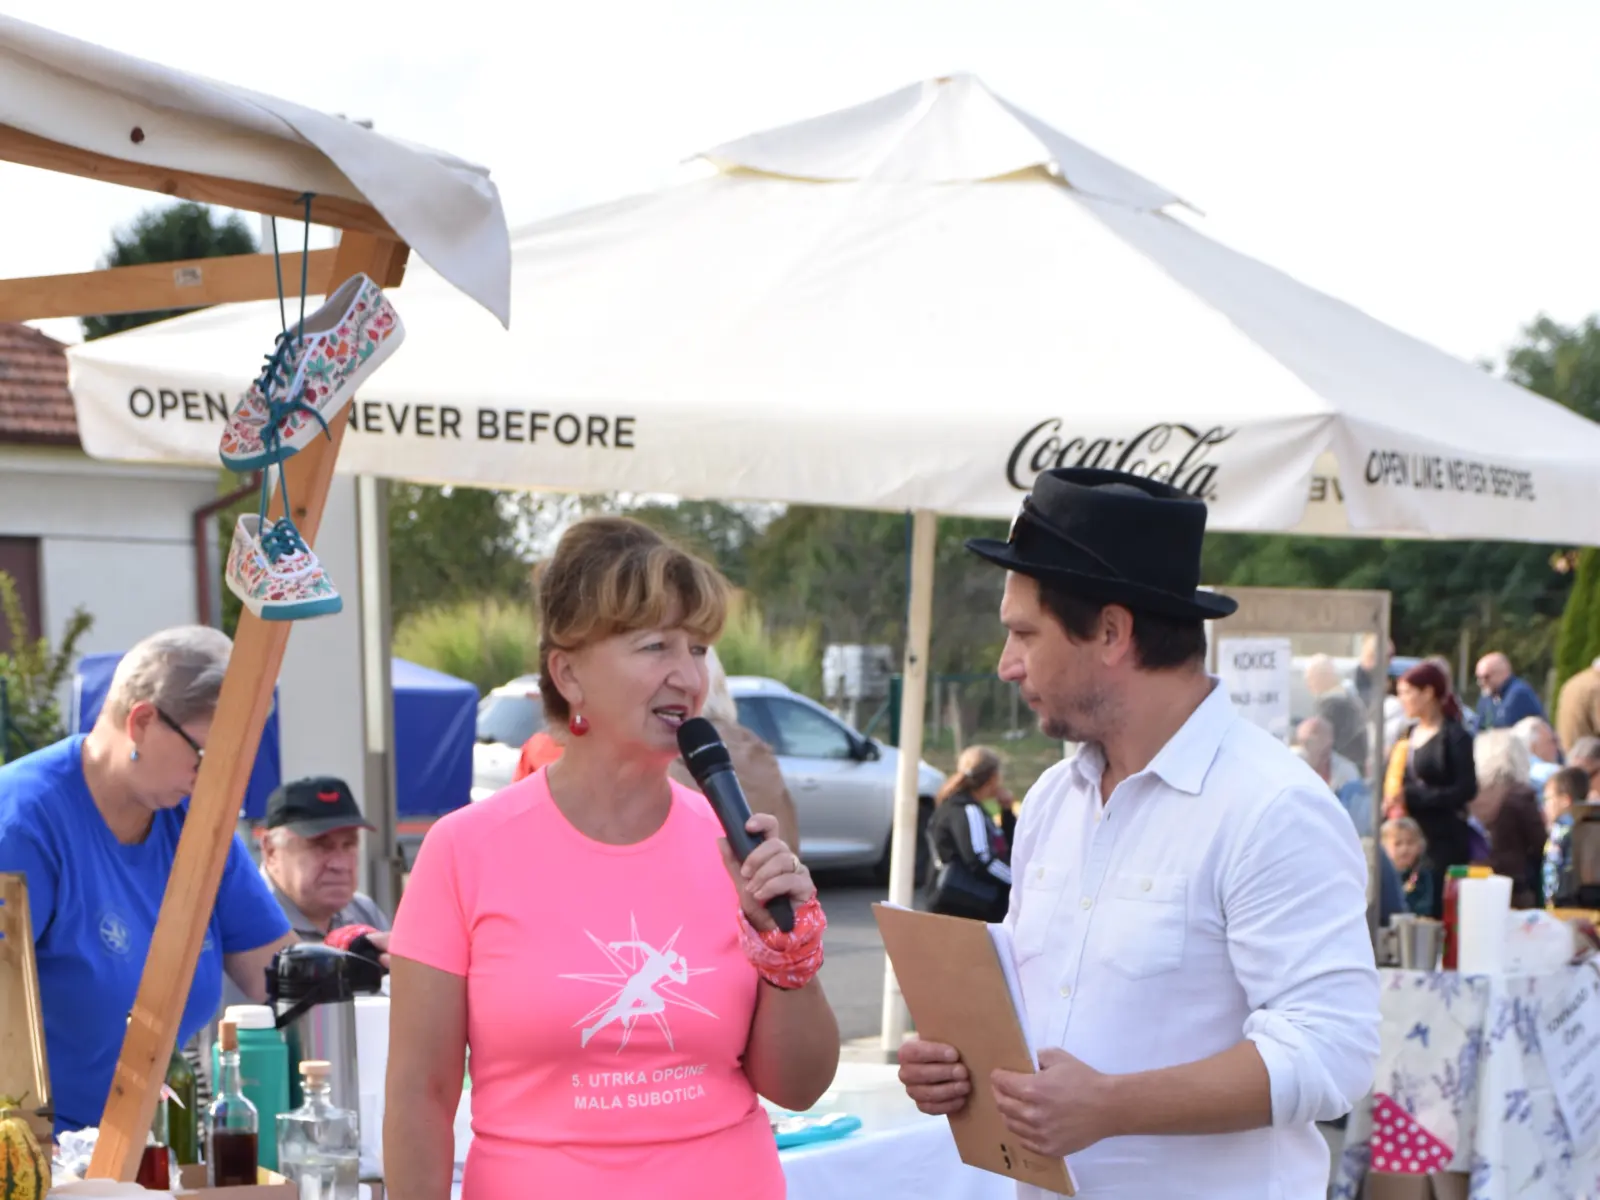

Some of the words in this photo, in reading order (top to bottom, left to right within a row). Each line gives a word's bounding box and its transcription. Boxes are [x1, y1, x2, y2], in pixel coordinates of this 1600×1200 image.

[129, 386, 229, 422] OPEN
[477, 408, 637, 449] BEFORE
[1006, 417, 1240, 501] Coca-Cola
[1365, 449, 1409, 487] OPEN
[571, 1073, 584, 1088] 5.
[588, 1071, 648, 1088] UTRKA
[574, 1095, 623, 1110] MALA
[627, 1084, 706, 1108] SUBOTICA
